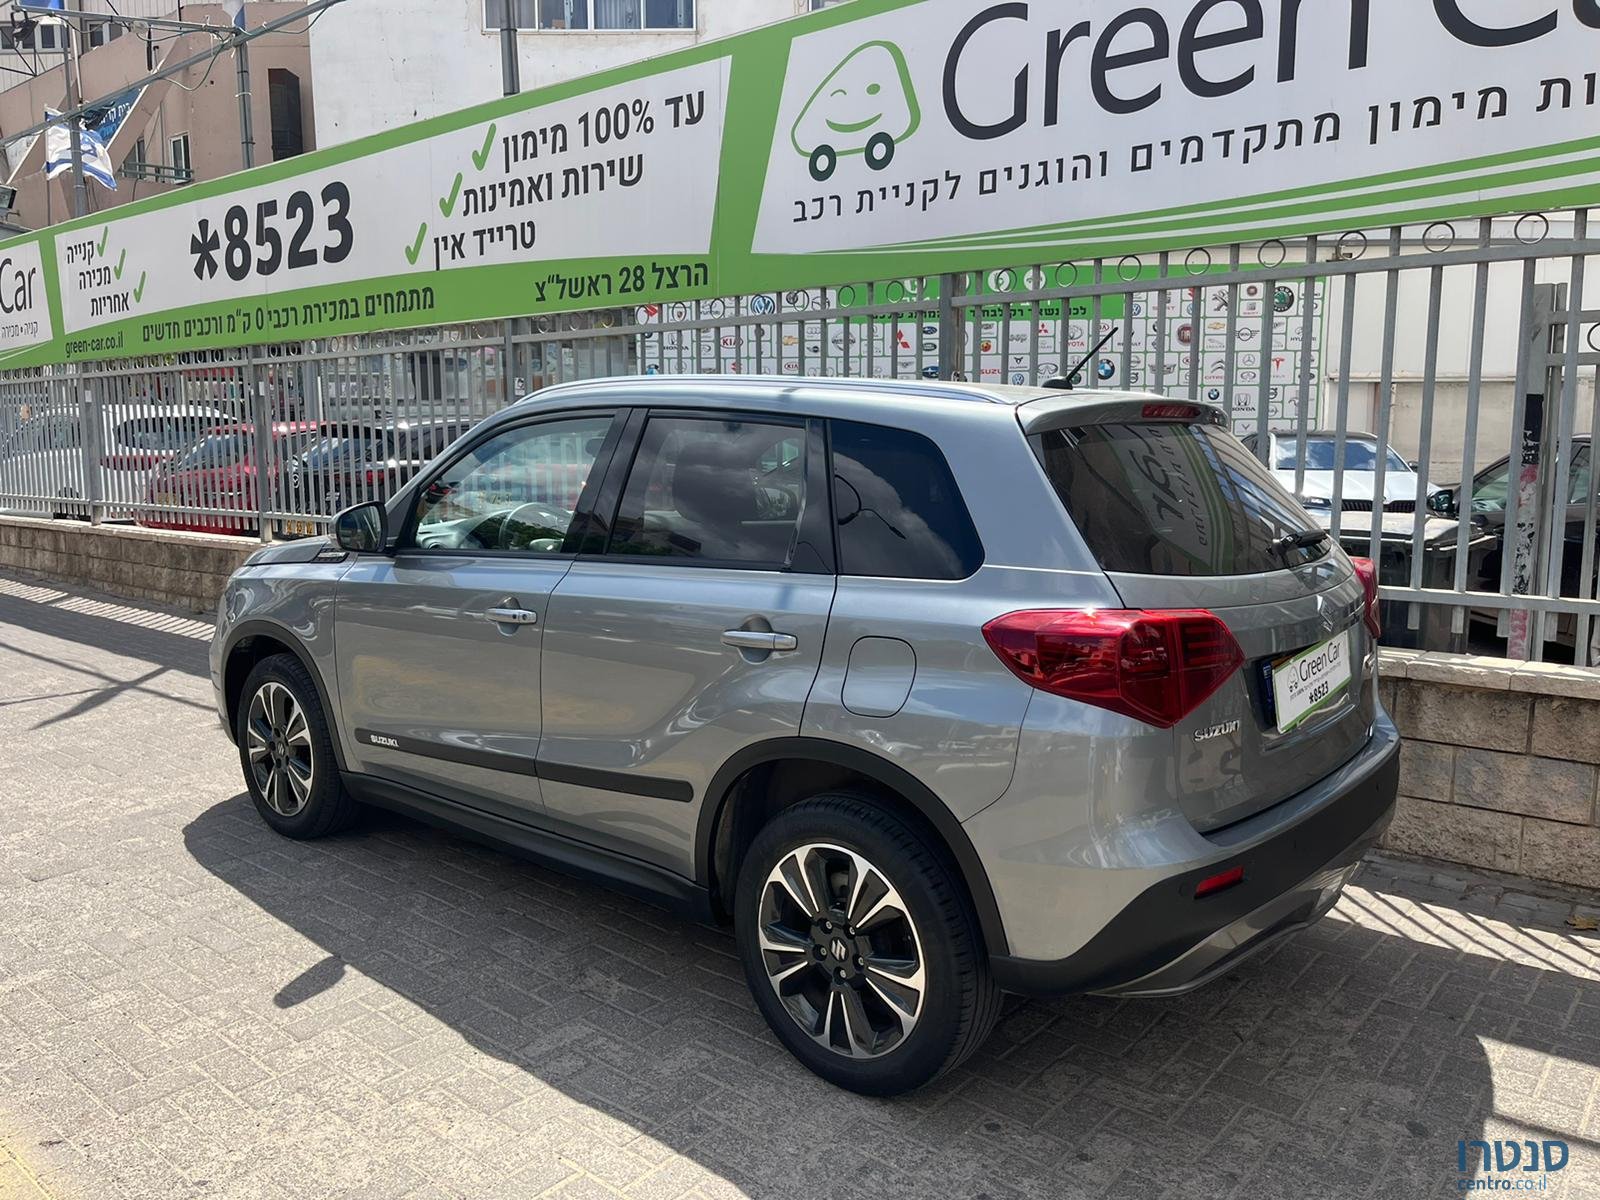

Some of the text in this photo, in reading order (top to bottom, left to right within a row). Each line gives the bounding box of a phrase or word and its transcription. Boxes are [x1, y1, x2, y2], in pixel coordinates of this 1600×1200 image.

[942, 0, 1369, 140] Green
[1368, 86, 1507, 145] מימון
[502, 90, 705, 173] עד 100% מימון
[1131, 111, 1340, 173] מתקדמים
[462, 153, 643, 217] שירות ואמינות
[978, 150, 1107, 196] והוגנים
[855, 170, 961, 214] לקניית
[792, 194, 842, 222] רכב
[67, 241, 95, 265] קנייה
[433, 219, 536, 271] טרייד אין
[0, 257, 36, 314] Car
[79, 265, 111, 290] מכירה
[618, 265, 646, 293] 28
[652, 262, 709, 289] הרצל
[90, 291, 130, 317] אחריות
[302, 298, 359, 326] במכירת
[365, 286, 434, 316] מתמחים
[142, 321, 180, 342] חדשים
[184, 318, 223, 338] ורכבים
[255, 307, 264, 331] 0
[268, 306, 298, 329] רכבי
[65, 331, 124, 358] green-car.co.il
[1298, 650, 1327, 683] Green
[1327, 642, 1341, 664] Car
[370, 734, 400, 748] SUZUKI
